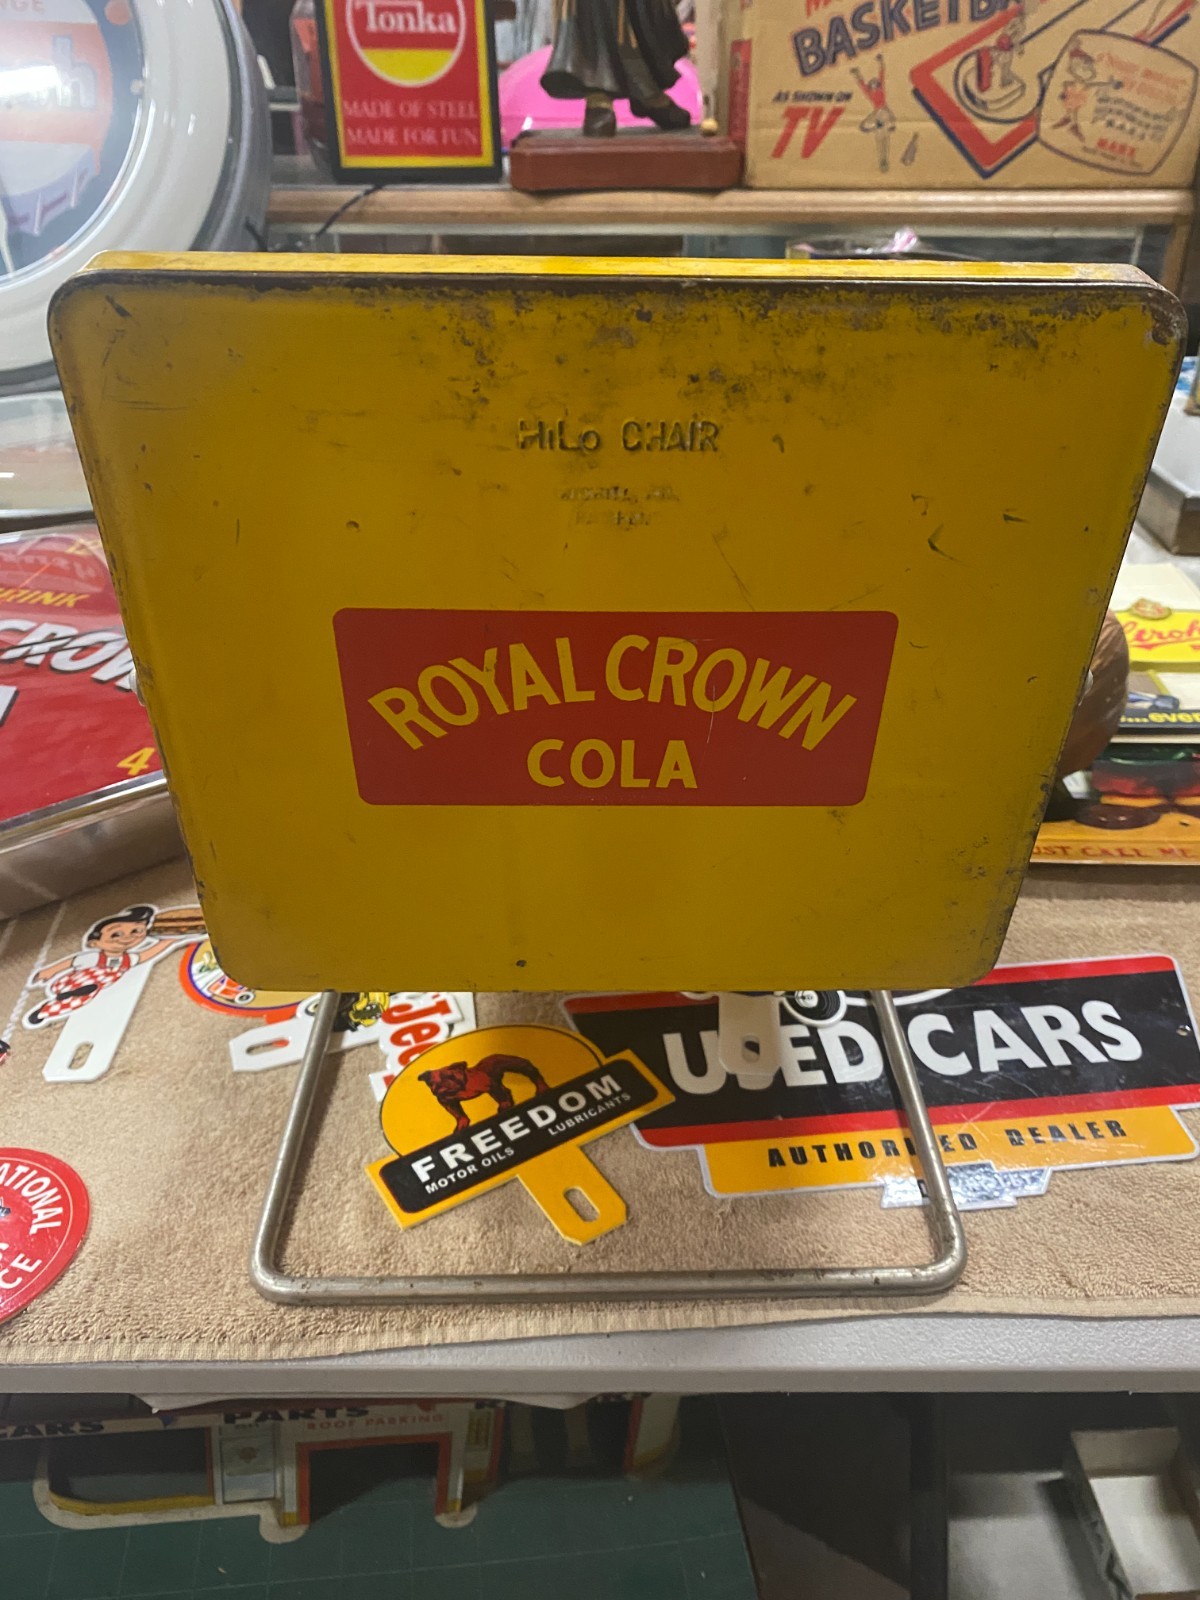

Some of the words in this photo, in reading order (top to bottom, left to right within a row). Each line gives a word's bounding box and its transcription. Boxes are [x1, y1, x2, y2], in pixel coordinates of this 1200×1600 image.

[354, 0, 457, 34] Tonka
[792, 0, 1009, 77] BASKE
[343, 100, 393, 118] MADE
[399, 100, 421, 118] OF
[427, 100, 477, 119] STEEL
[771, 106, 846, 159] TV
[348, 127, 396, 145] MADE
[403, 127, 436, 146] FOR
[441, 127, 478, 146] FUN
[622, 419, 719, 452] CHAIR
[368, 636, 596, 750] ROYAL
[605, 634, 857, 751] CROWN
[117, 747, 155, 775] 4
[527, 739, 698, 789] COLA
[663, 1022, 884, 1095] UED
[907, 1000, 1142, 1076] CARS
[411, 1074, 622, 1182] FREEDOM
[548, 1092, 632, 1136] LUBRICANTS
[768, 1132, 977, 1168] AUTHORIED
[1005, 1119, 1128, 1147] DEALER
[425, 1163, 478, 1195] MOTOR
[481, 1146, 515, 1168] OILS
[307, 1420, 355, 1430] ROOF
